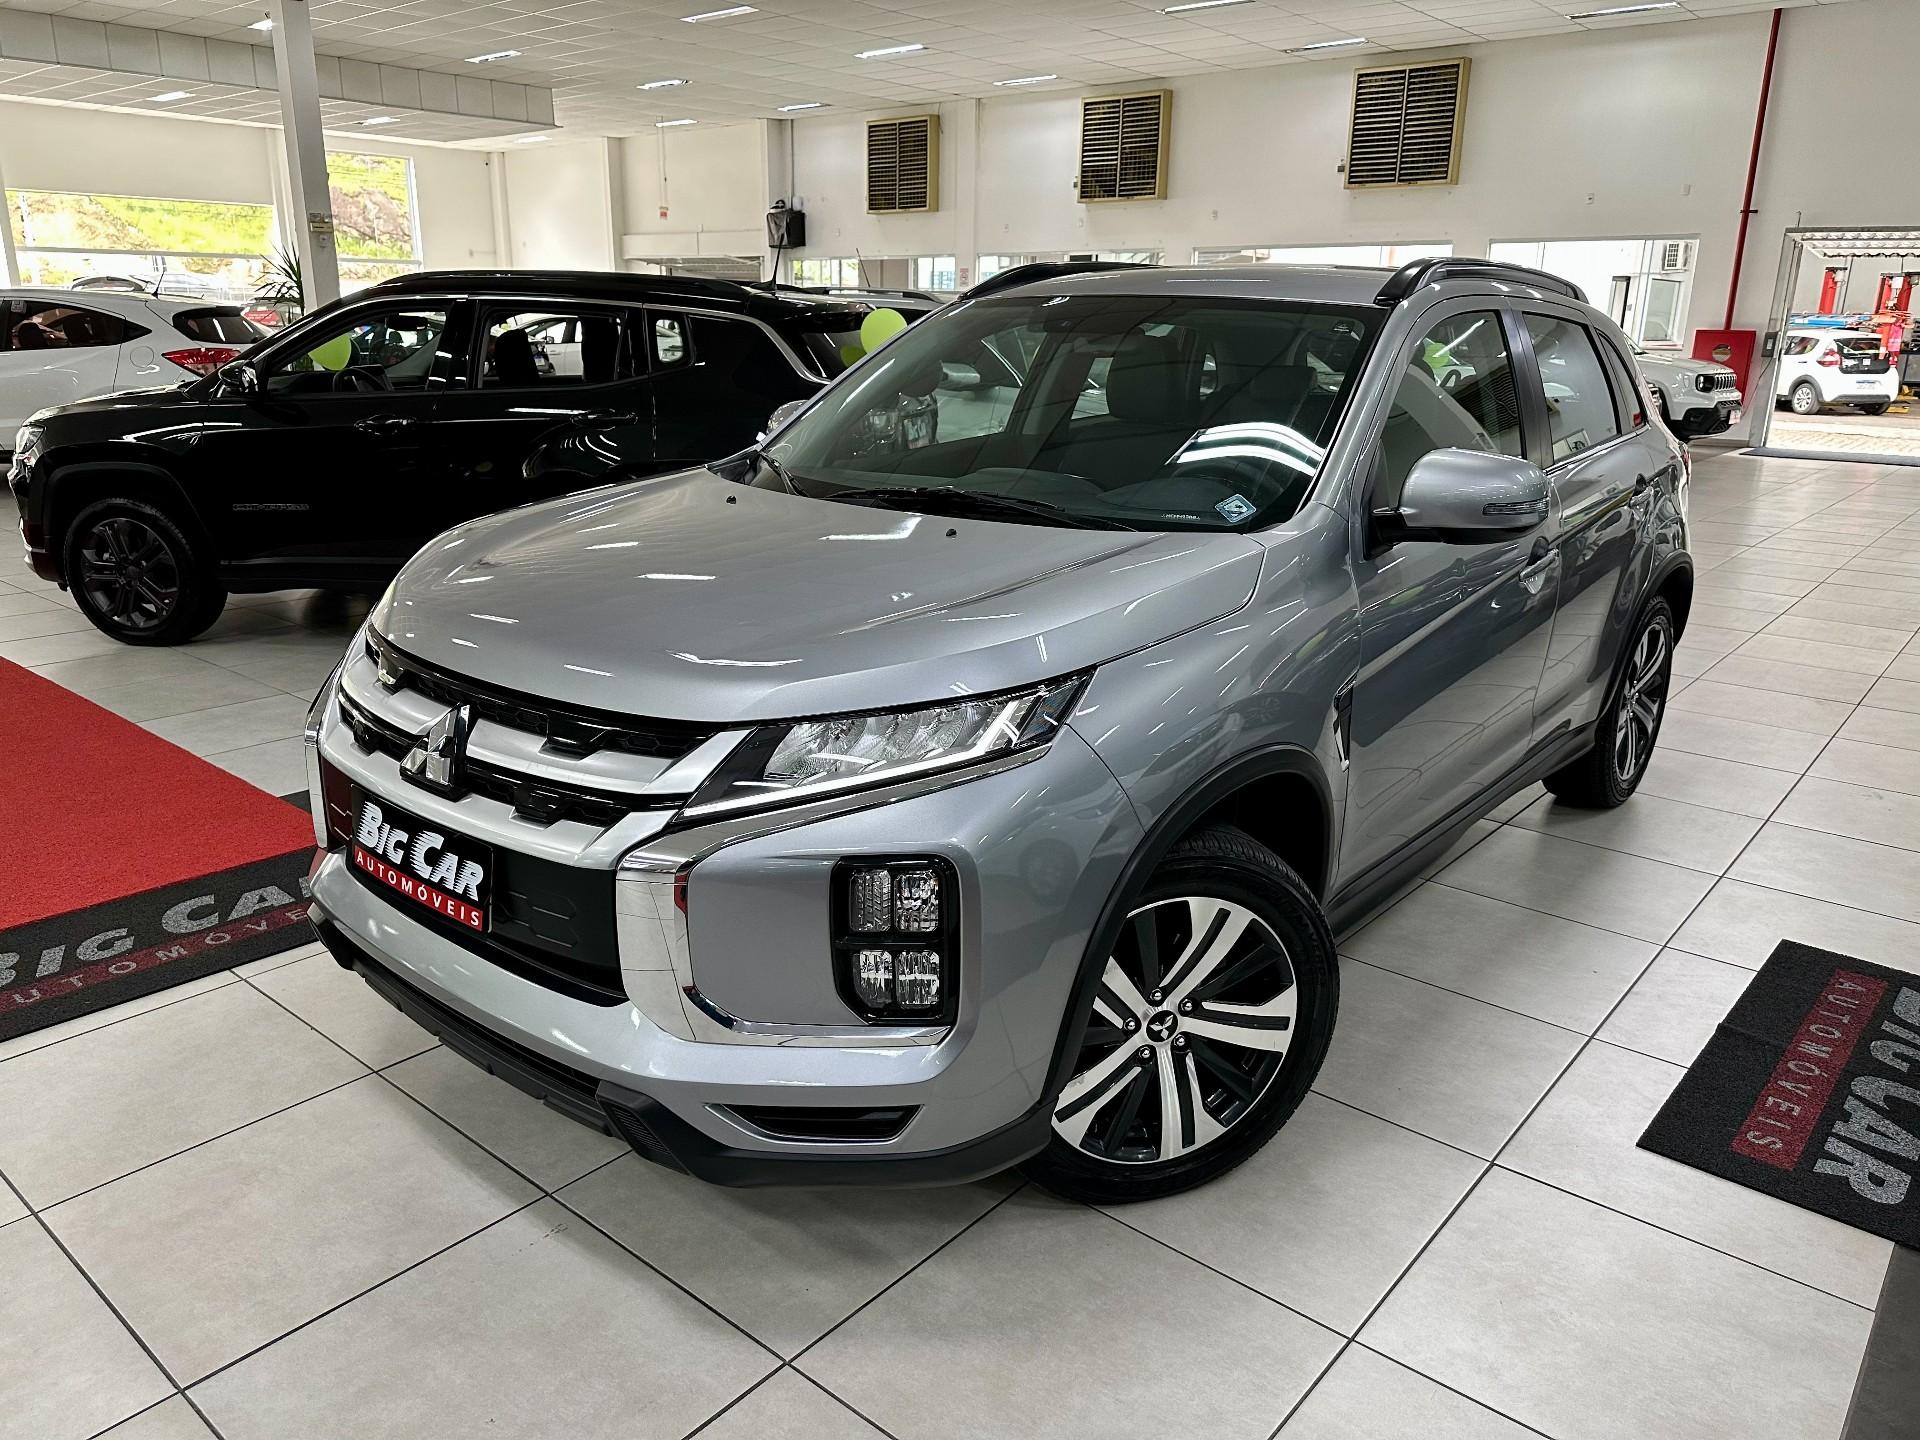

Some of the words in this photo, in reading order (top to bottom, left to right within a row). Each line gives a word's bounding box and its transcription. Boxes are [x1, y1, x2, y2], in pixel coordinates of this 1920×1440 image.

[356, 800, 409, 865] BIG
[409, 829, 484, 901] CAR
[356, 850, 479, 927] AUTOMÓVEIS
[161, 876, 312, 933] CA
[1746, 978, 1867, 1152] AUTOMÓVEIS
